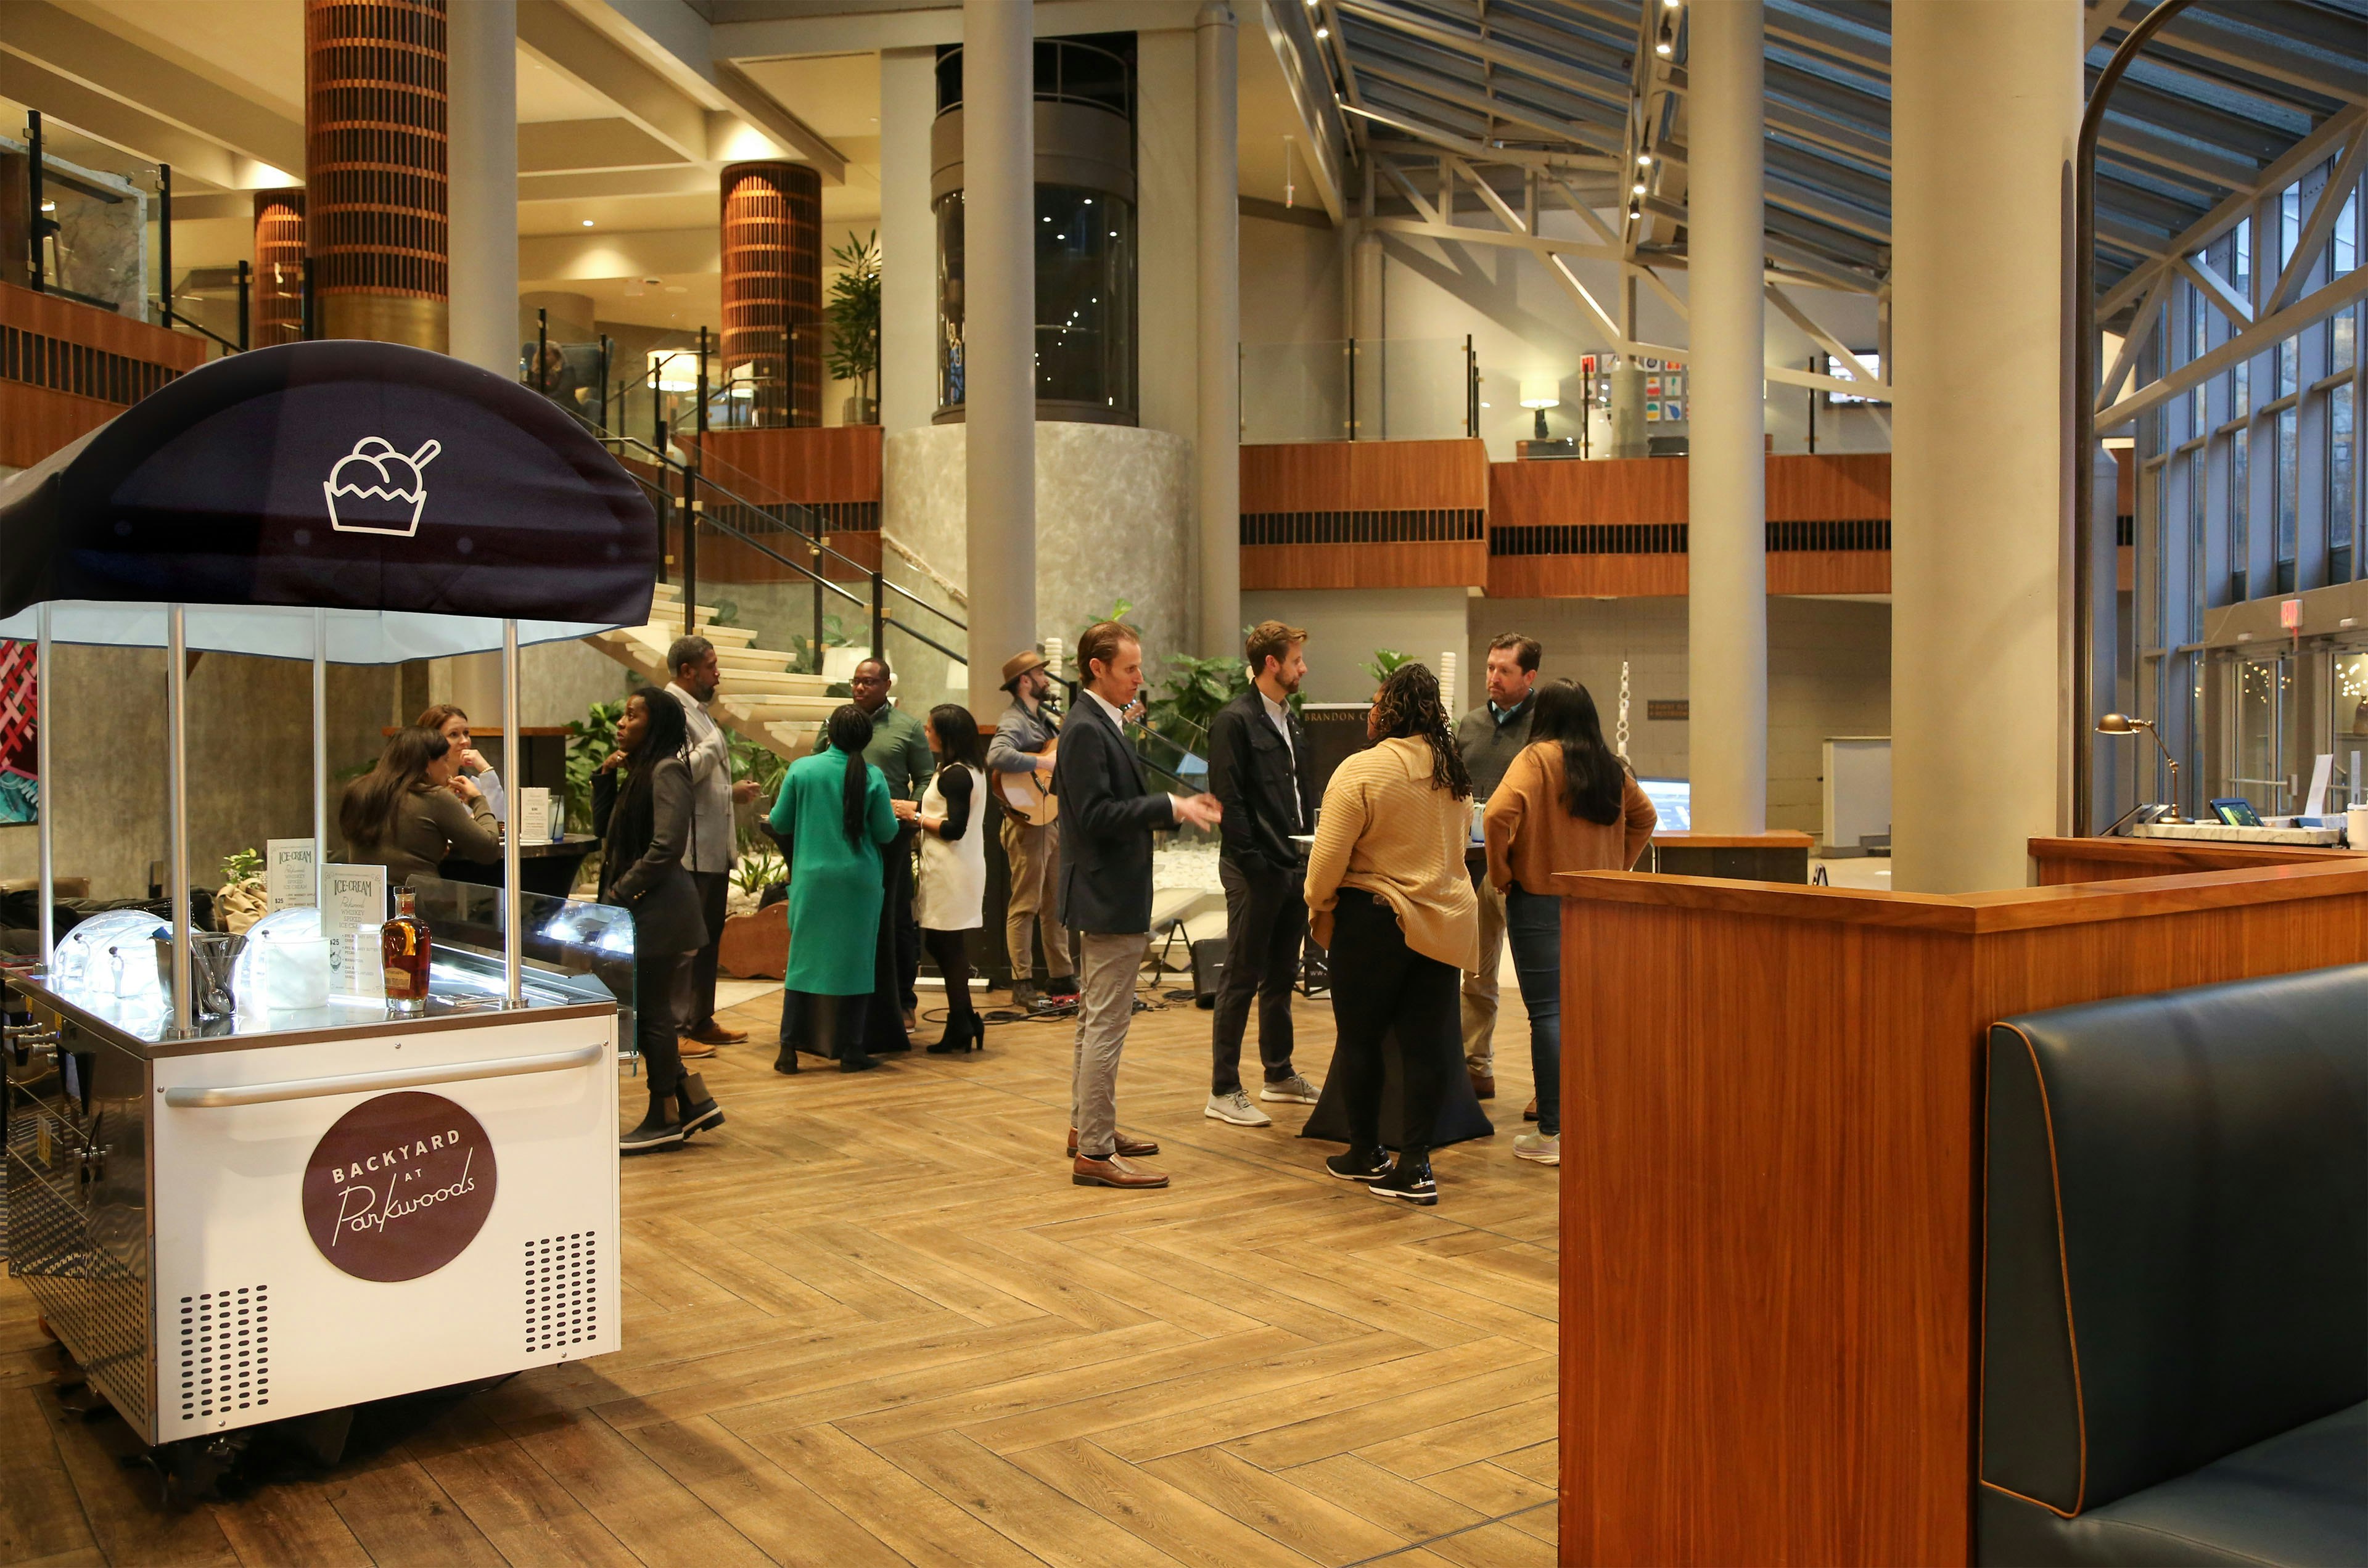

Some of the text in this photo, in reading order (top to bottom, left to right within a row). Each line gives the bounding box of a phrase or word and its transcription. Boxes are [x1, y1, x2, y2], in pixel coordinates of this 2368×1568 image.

[1305, 713, 1355, 721] BRANDON
[279, 851, 311, 864] ICE-CREAM
[334, 879, 372, 897] ICE-CREAM
[332, 1130, 459, 1183] BACKYARD
[405, 1168, 422, 1181] AT
[332, 1147, 475, 1247] Parkwoods
